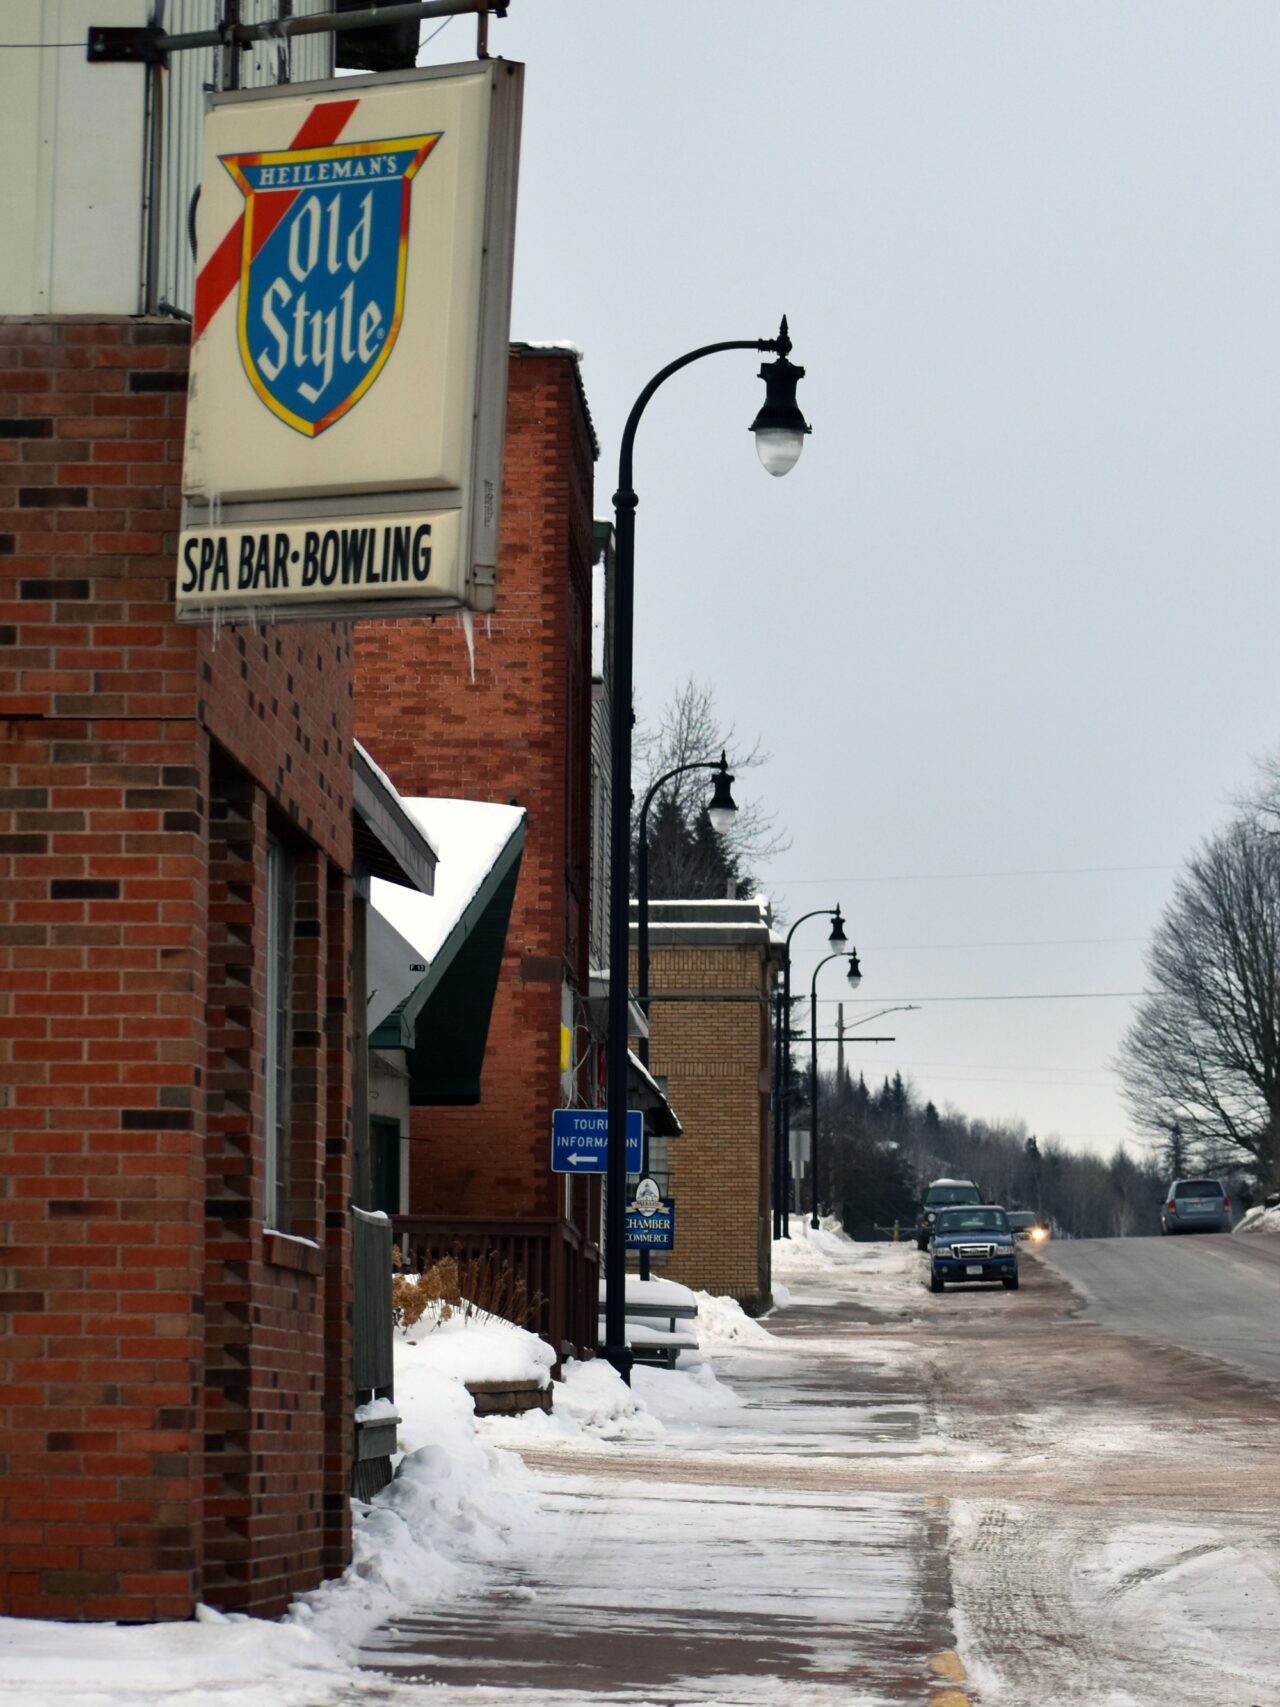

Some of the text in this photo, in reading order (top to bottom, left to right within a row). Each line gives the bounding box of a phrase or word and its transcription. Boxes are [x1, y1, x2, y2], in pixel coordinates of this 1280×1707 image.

[259, 155, 398, 186] HEILEMAN'S
[288, 189, 373, 283] Old
[257, 276, 382, 404] Style
[181, 524, 432, 593] SPA BAR BOWLING
[557, 1136, 638, 1148] INFORMAN
[573, 1119, 609, 1130] TOURI
